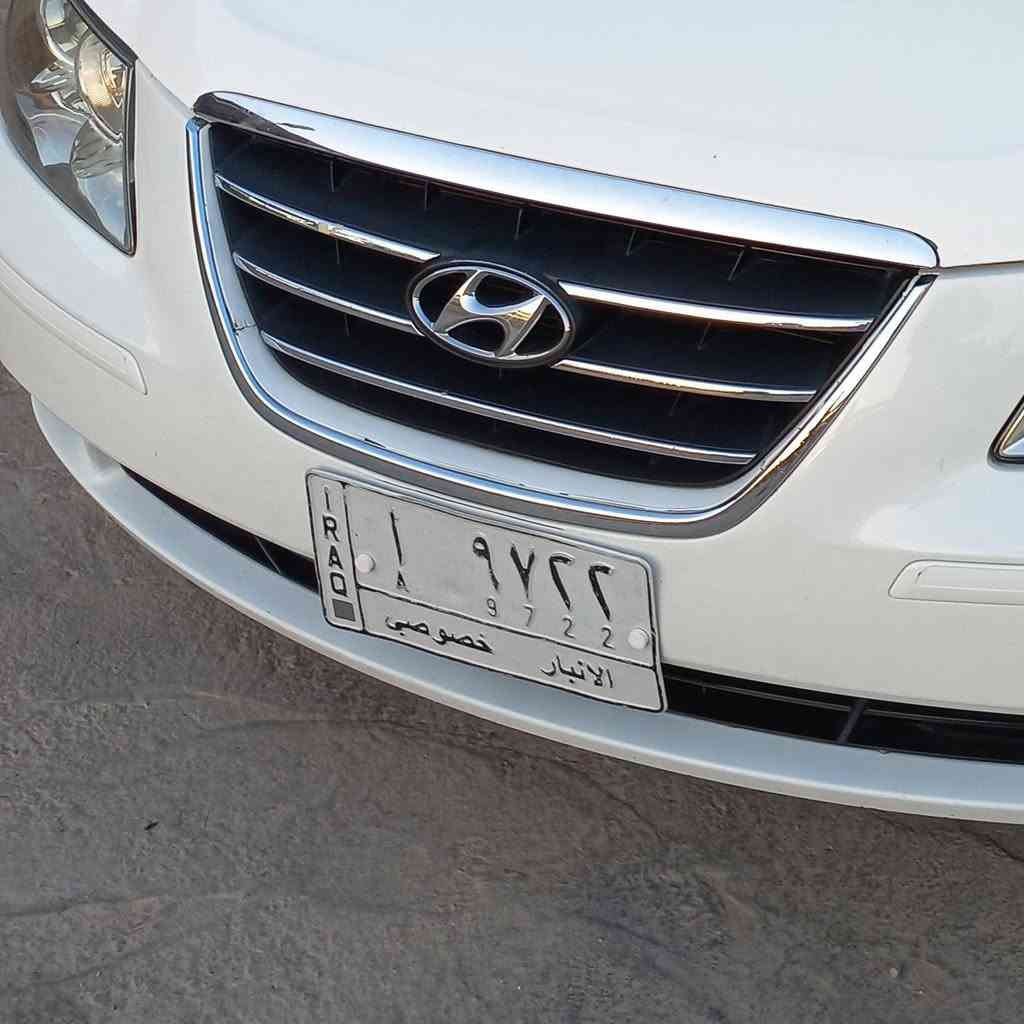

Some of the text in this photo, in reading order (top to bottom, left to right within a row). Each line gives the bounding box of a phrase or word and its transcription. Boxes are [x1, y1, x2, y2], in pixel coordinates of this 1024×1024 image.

[322, 486, 348, 597] IRAQ
[472, 536, 613, 622] ٩٧٢٢
[486, 597, 616, 649] 9722
